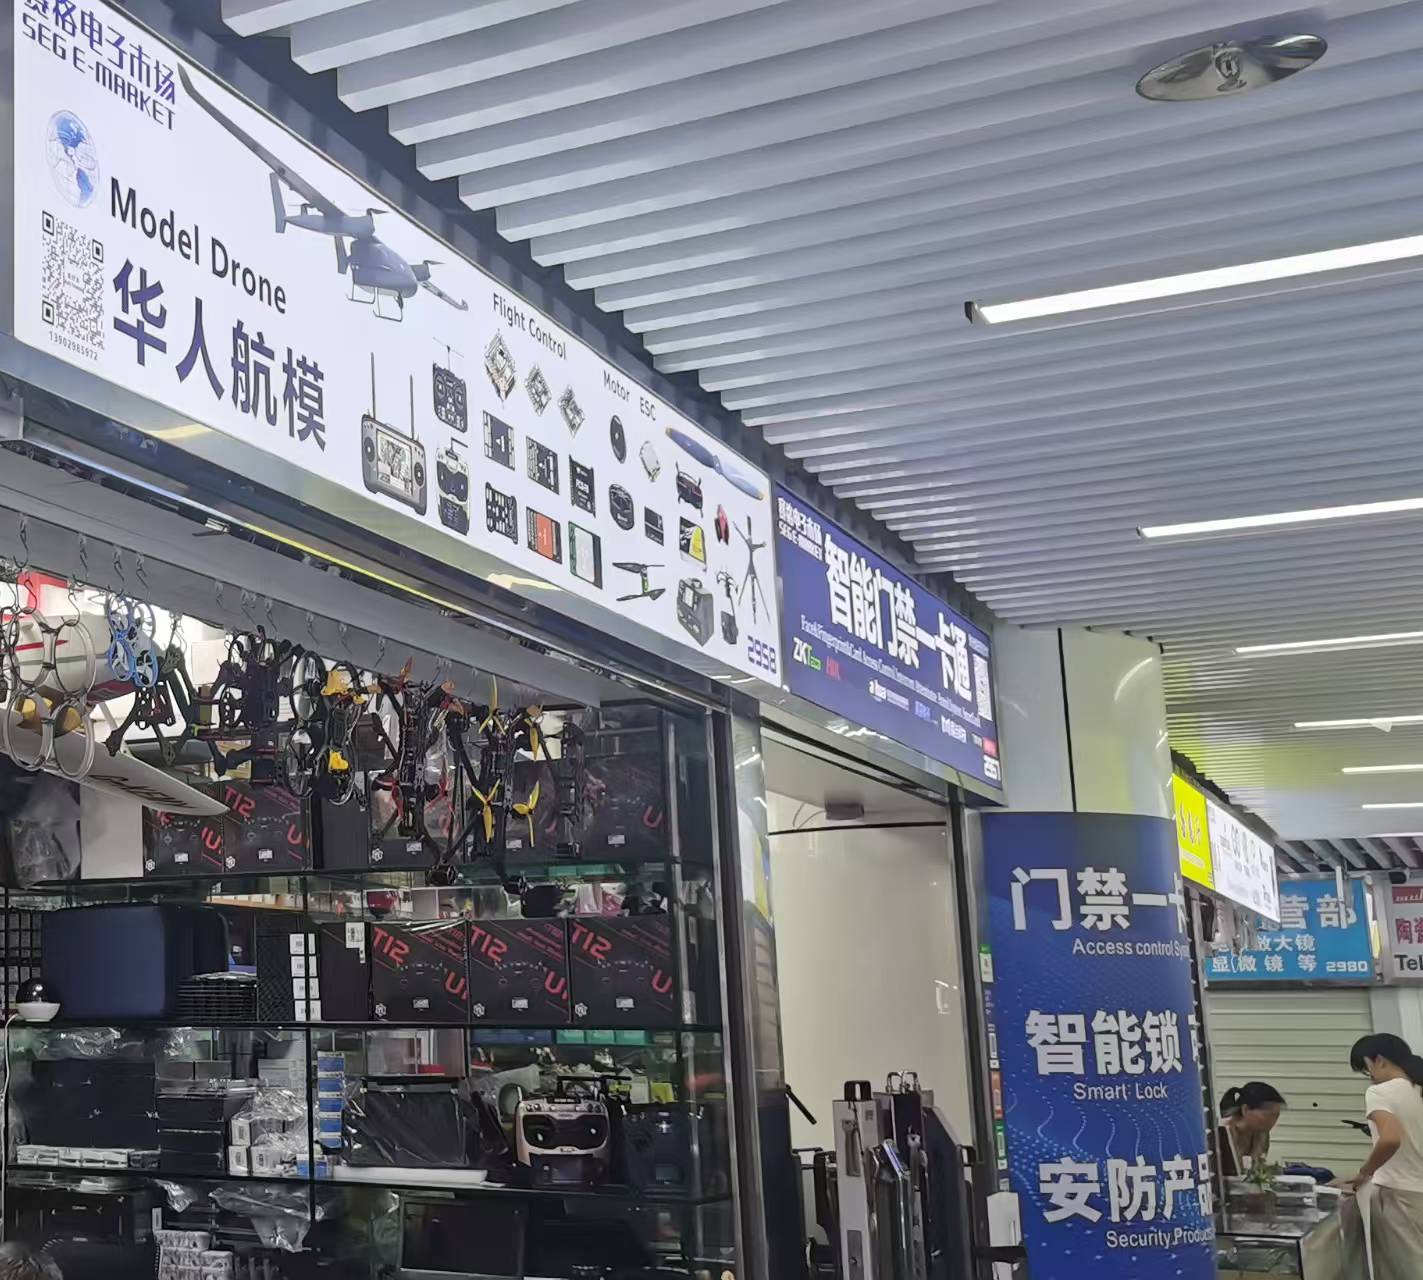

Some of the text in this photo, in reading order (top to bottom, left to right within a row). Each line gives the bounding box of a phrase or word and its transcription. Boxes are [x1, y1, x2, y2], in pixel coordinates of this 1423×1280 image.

[23, 13, 175, 130] SEG E-MARKET
[111, 177, 287, 314] Model Drone
[493, 293, 566, 360] Flight Control
[113, 258, 326, 452] 华人航模
[603, 370, 656, 421] Motor ESC
[825, 533, 972, 702] 智能门禁一卡通
[748, 635, 776, 674] 2958
[1258, 894, 1357, 931] 营部
[1072, 938, 1133, 955] Access
[1136, 941, 1173, 956] control
[1212, 955, 1368, 973] 显微镜等 2980
[1073, 1082, 1168, 1101] Smart Lock
[1106, 1228, 1172, 1249] Security
